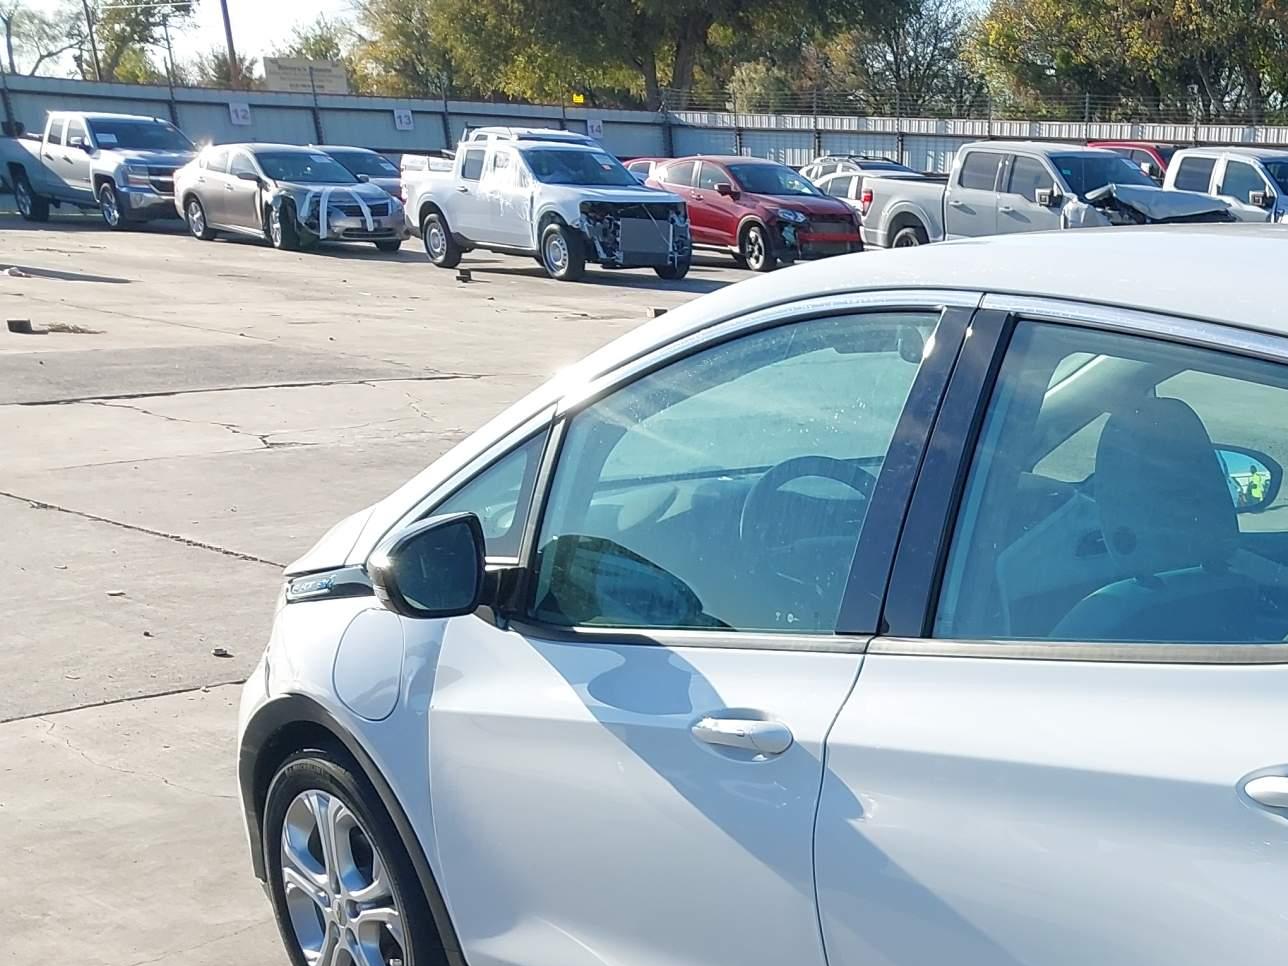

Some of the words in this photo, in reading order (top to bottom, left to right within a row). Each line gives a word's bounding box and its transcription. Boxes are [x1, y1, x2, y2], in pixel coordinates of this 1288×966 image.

[233, 108, 250, 121] 12
[396, 114, 412, 126] 13
[588, 124, 602, 134] 14
